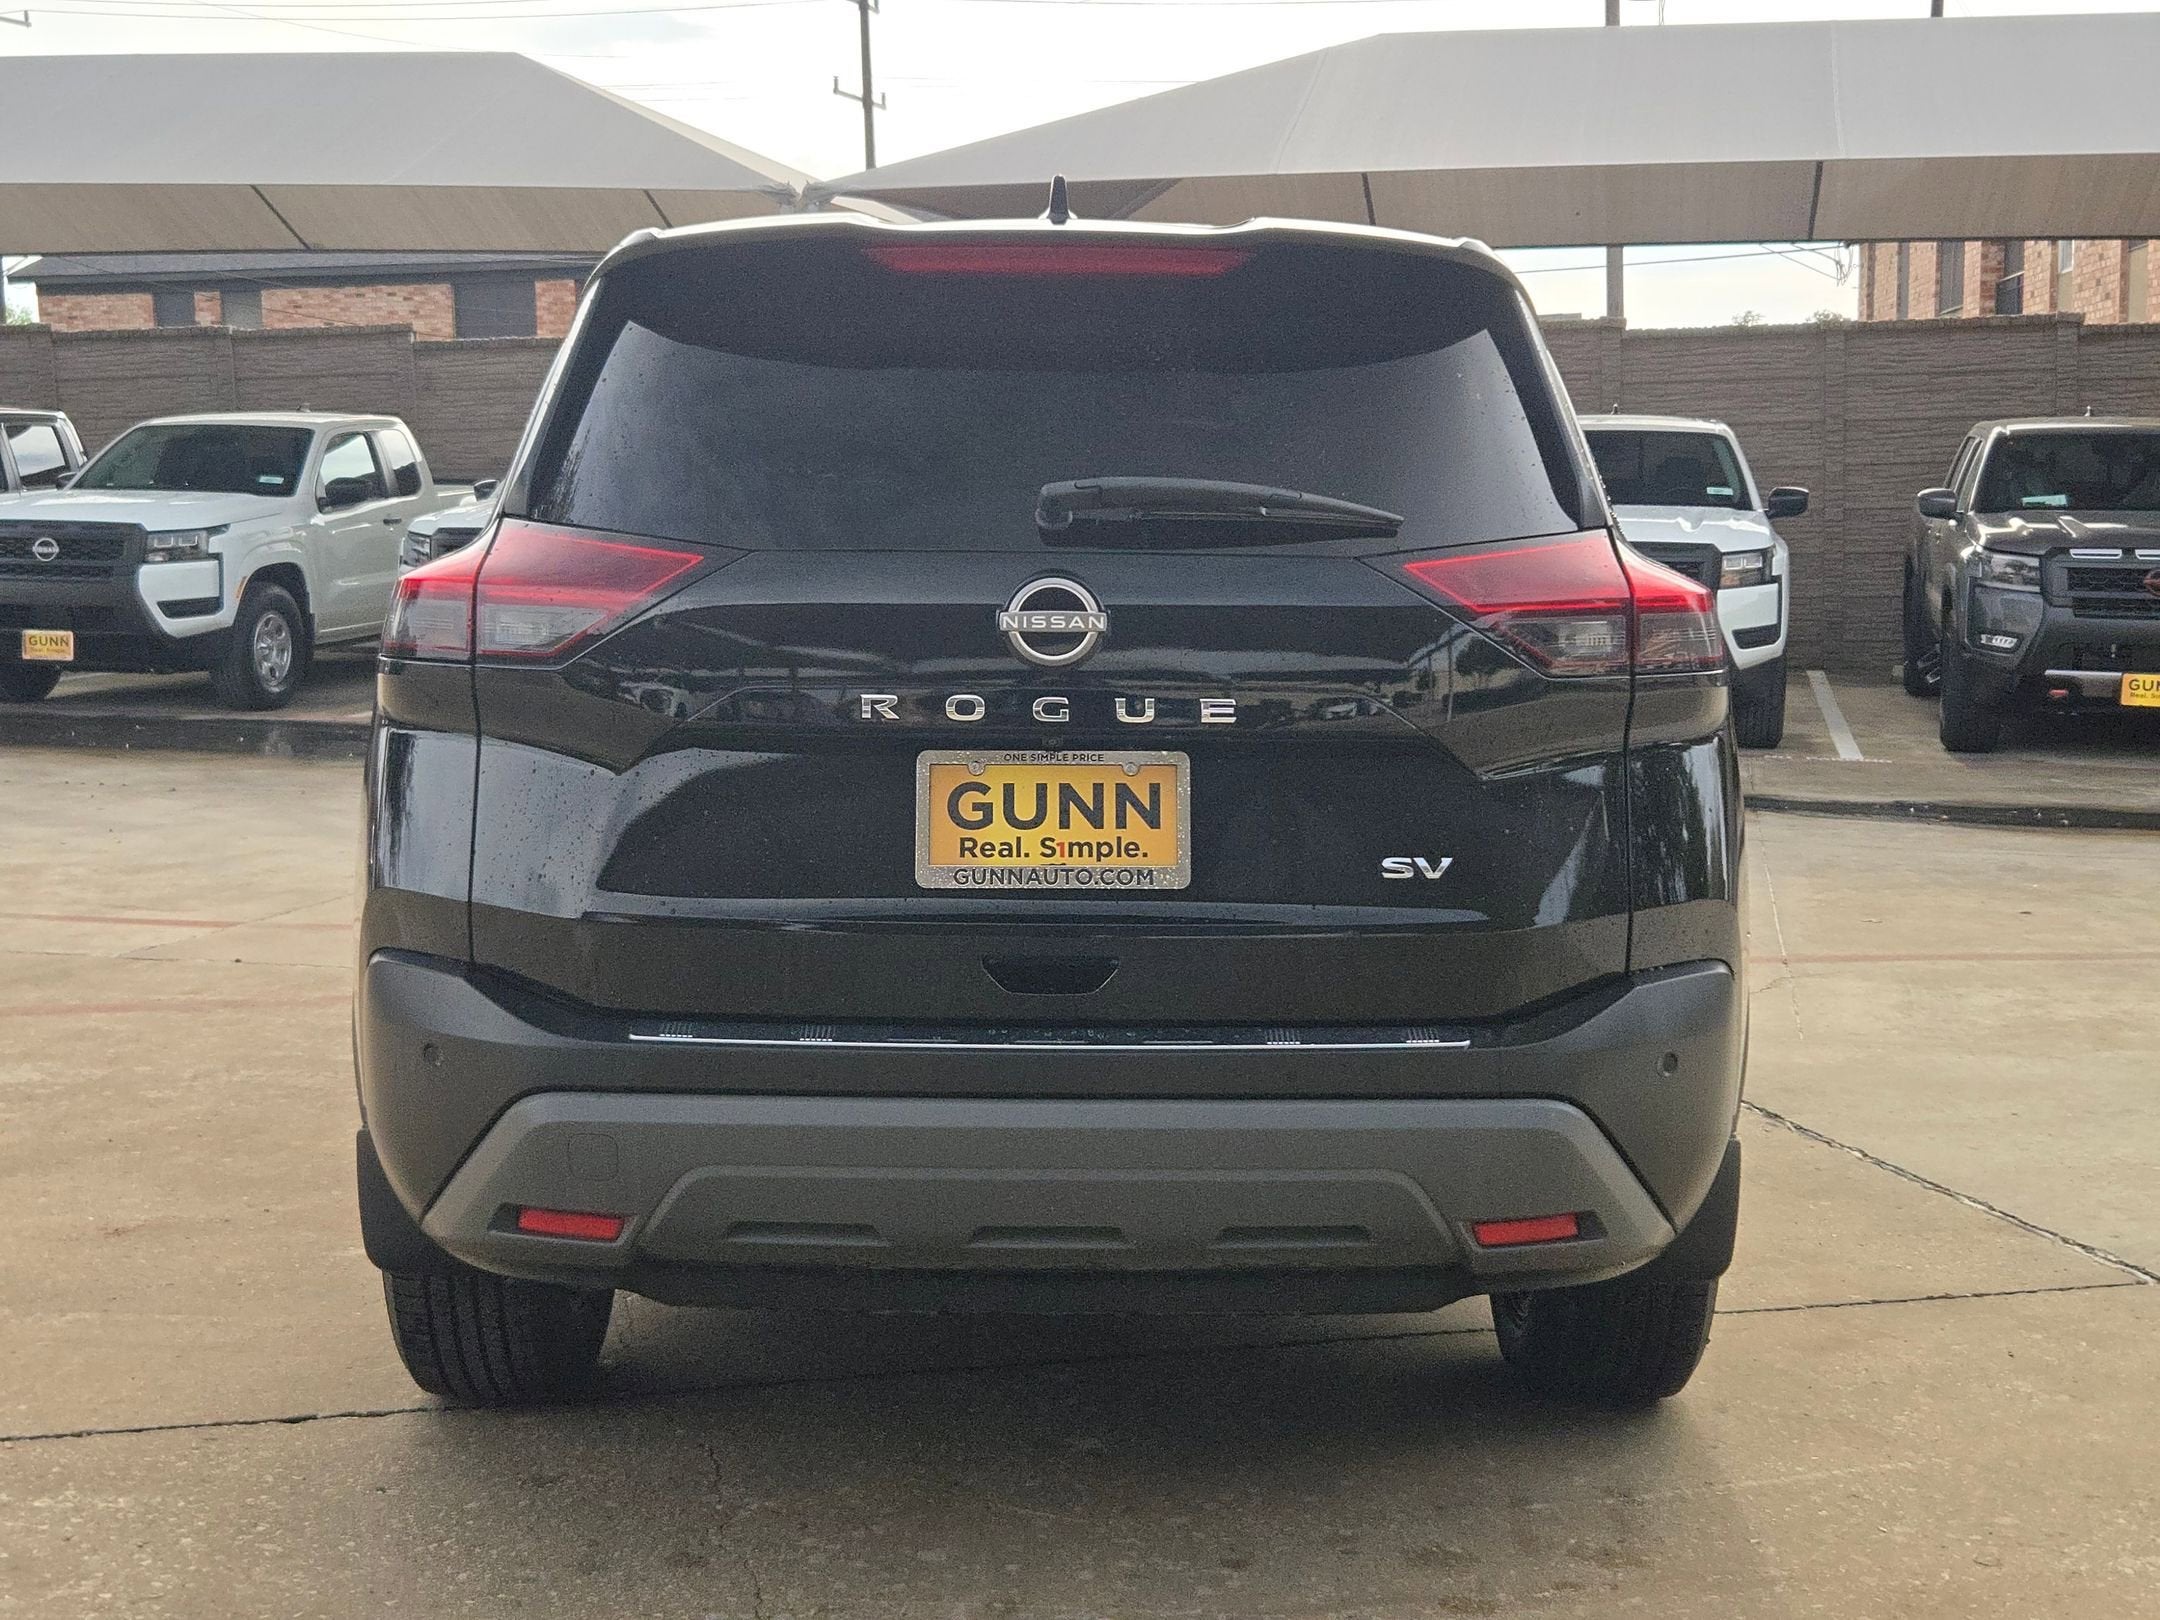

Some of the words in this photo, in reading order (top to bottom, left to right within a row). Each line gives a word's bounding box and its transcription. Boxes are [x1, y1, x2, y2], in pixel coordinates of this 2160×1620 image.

[1003, 613, 1105, 631] NISSAN
[29, 636, 69, 646] GUNN
[860, 694, 1238, 723] ROGUE
[1003, 753, 1027, 762] ONE
[1030, 753, 1069, 762] SIMPLE
[1072, 753, 1105, 762] PRICE
[947, 781, 1161, 830] GUNN
[959, 836, 1030, 858] Real.
[953, 868, 1154, 886] GUNNAUTO.COM
[1381, 857, 1453, 879] SV
